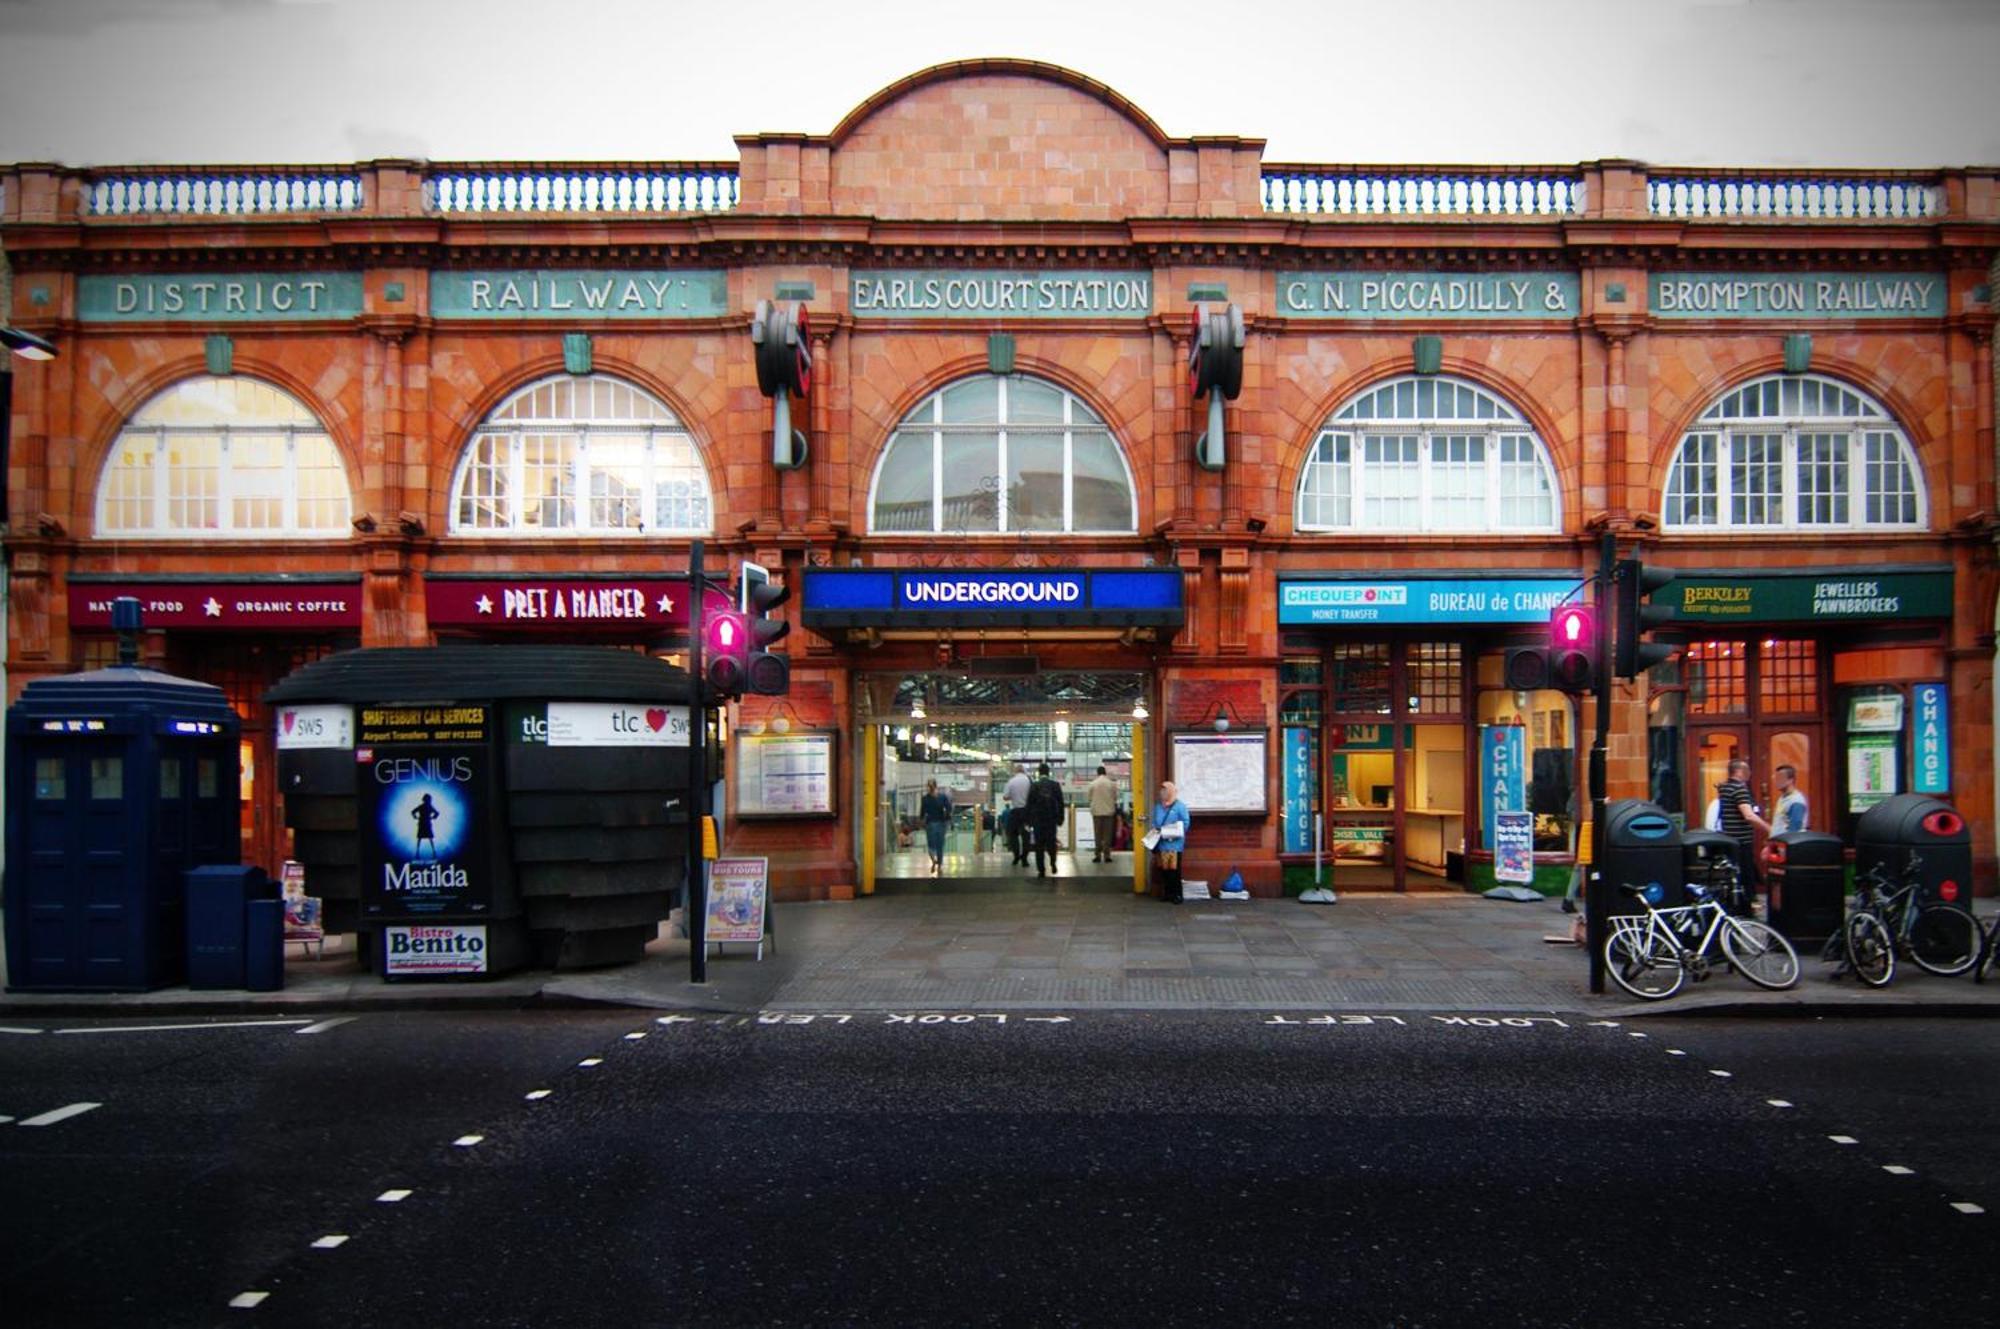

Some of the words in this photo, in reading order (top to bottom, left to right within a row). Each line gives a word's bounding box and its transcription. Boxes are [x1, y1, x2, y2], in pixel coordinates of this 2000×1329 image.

[115, 281, 326, 313] DISTRICT
[854, 279, 942, 310] EARLS
[945, 279, 1035, 310] COURT
[1038, 279, 1149, 310] STATION
[1361, 281, 1530, 311] PICCADILLY
[1544, 281, 1567, 311] &
[1659, 281, 1805, 311] BROMPTON
[1815, 281, 1934, 311] RAILWAY
[905, 581, 1080, 602] UNDERGROUND
[1287, 588, 1403, 602] CHEQUEPOINT
[1813, 581, 1879, 599] JEWELLERS
[150, 602, 184, 612] FOOD
[236, 601, 293, 612] ORGANIC
[297, 601, 347, 612] COFFEE
[503, 588, 549, 618] PRET
[553, 589, 567, 618] A
[571, 589, 647, 618] MANGER
[1429, 592, 1486, 612] BUREAU
[1491, 592, 1509, 611] de
[1812, 597, 1900, 614] PAWNBROKERS
[1311, 609, 1339, 620] MONEY
[1341, 609, 1379, 620] TRANSFER
[362, 709, 421, 726] SHAFTESBURY
[424, 709, 441, 725] CAR
[443, 707, 485, 724] SERVICES
[522, 715, 548, 736] tlc
[611, 709, 640, 733] tlc
[1922, 687, 1939, 787] CHANGE
[374, 756, 473, 785] GENIUS
[1296, 746, 1309, 848] CHANGE
[384, 862, 469, 891] Matilda
[389, 932, 485, 954] Benito
[410, 927, 454, 938] Bistro
[884, 1013, 1008, 1025] LOOK
[1264, 1014, 1407, 1026] LEFT
[1430, 1015, 1570, 1028] LOOK
